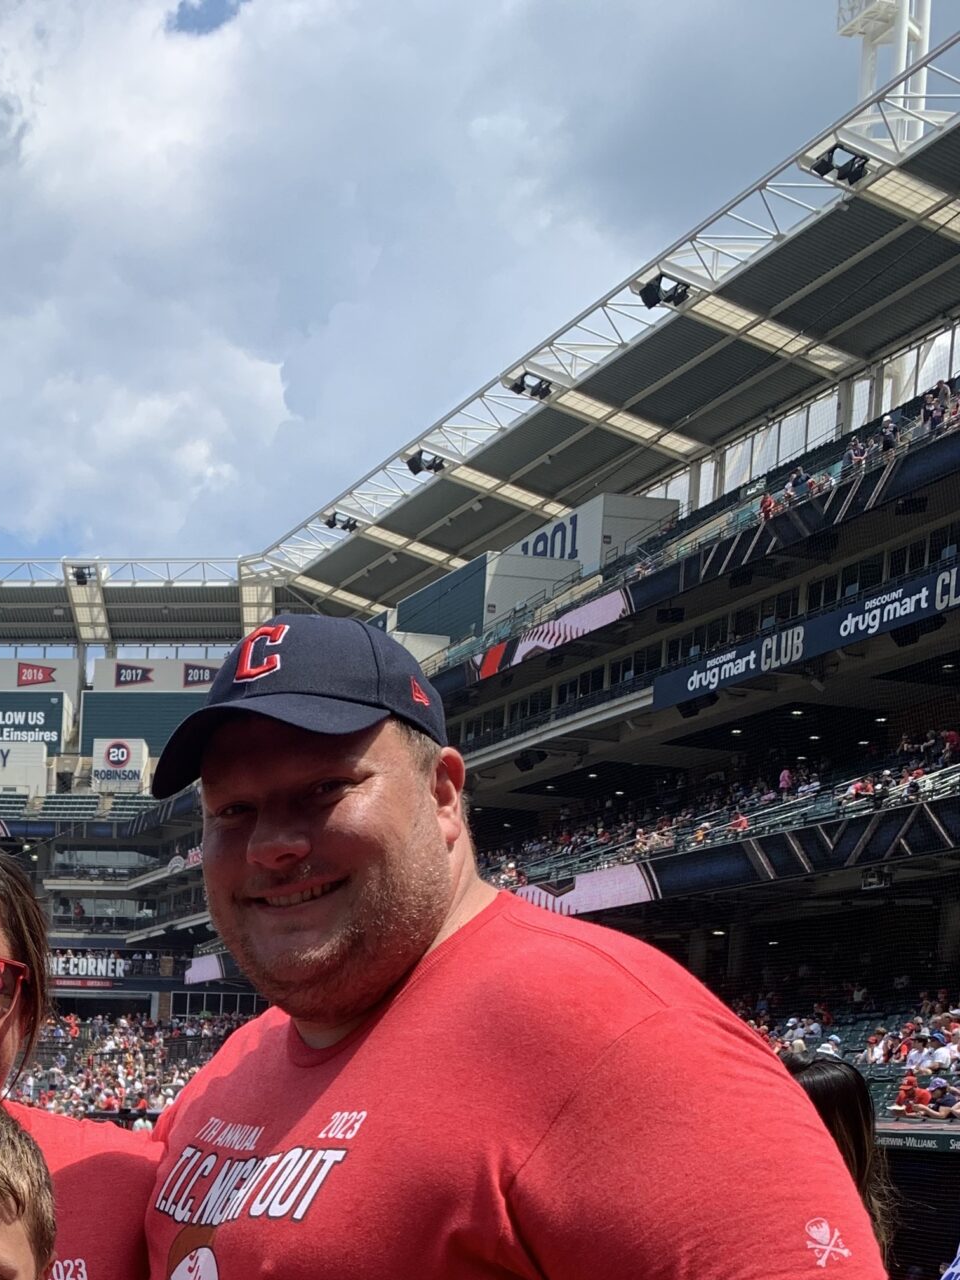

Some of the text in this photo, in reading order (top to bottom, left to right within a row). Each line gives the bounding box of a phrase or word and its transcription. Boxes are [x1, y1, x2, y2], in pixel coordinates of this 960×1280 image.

[865, 588, 903, 611] DISCOUNT
[840, 607, 881, 637] drug
[883, 586, 928, 622] mart
[233, 624, 290, 683] C
[687, 626, 804, 691] drug mart CLUB
[707, 650, 736, 668] DISCOUNT
[21, 667, 44, 681] 2016
[120, 669, 142, 681] 2017
[188, 669, 210, 681] 2018
[28, 711, 45, 725] US
[109, 748, 128, 761] 20
[94, 769, 141, 781] ROBINSON
[69, 957, 125, 977] CORNER
[195, 1117, 265, 1150] 7TH ANNUAL
[318, 1110, 367, 1139] 2023
[193, 1152, 282, 1225] NIGHT
[249, 1147, 348, 1220] OUT
